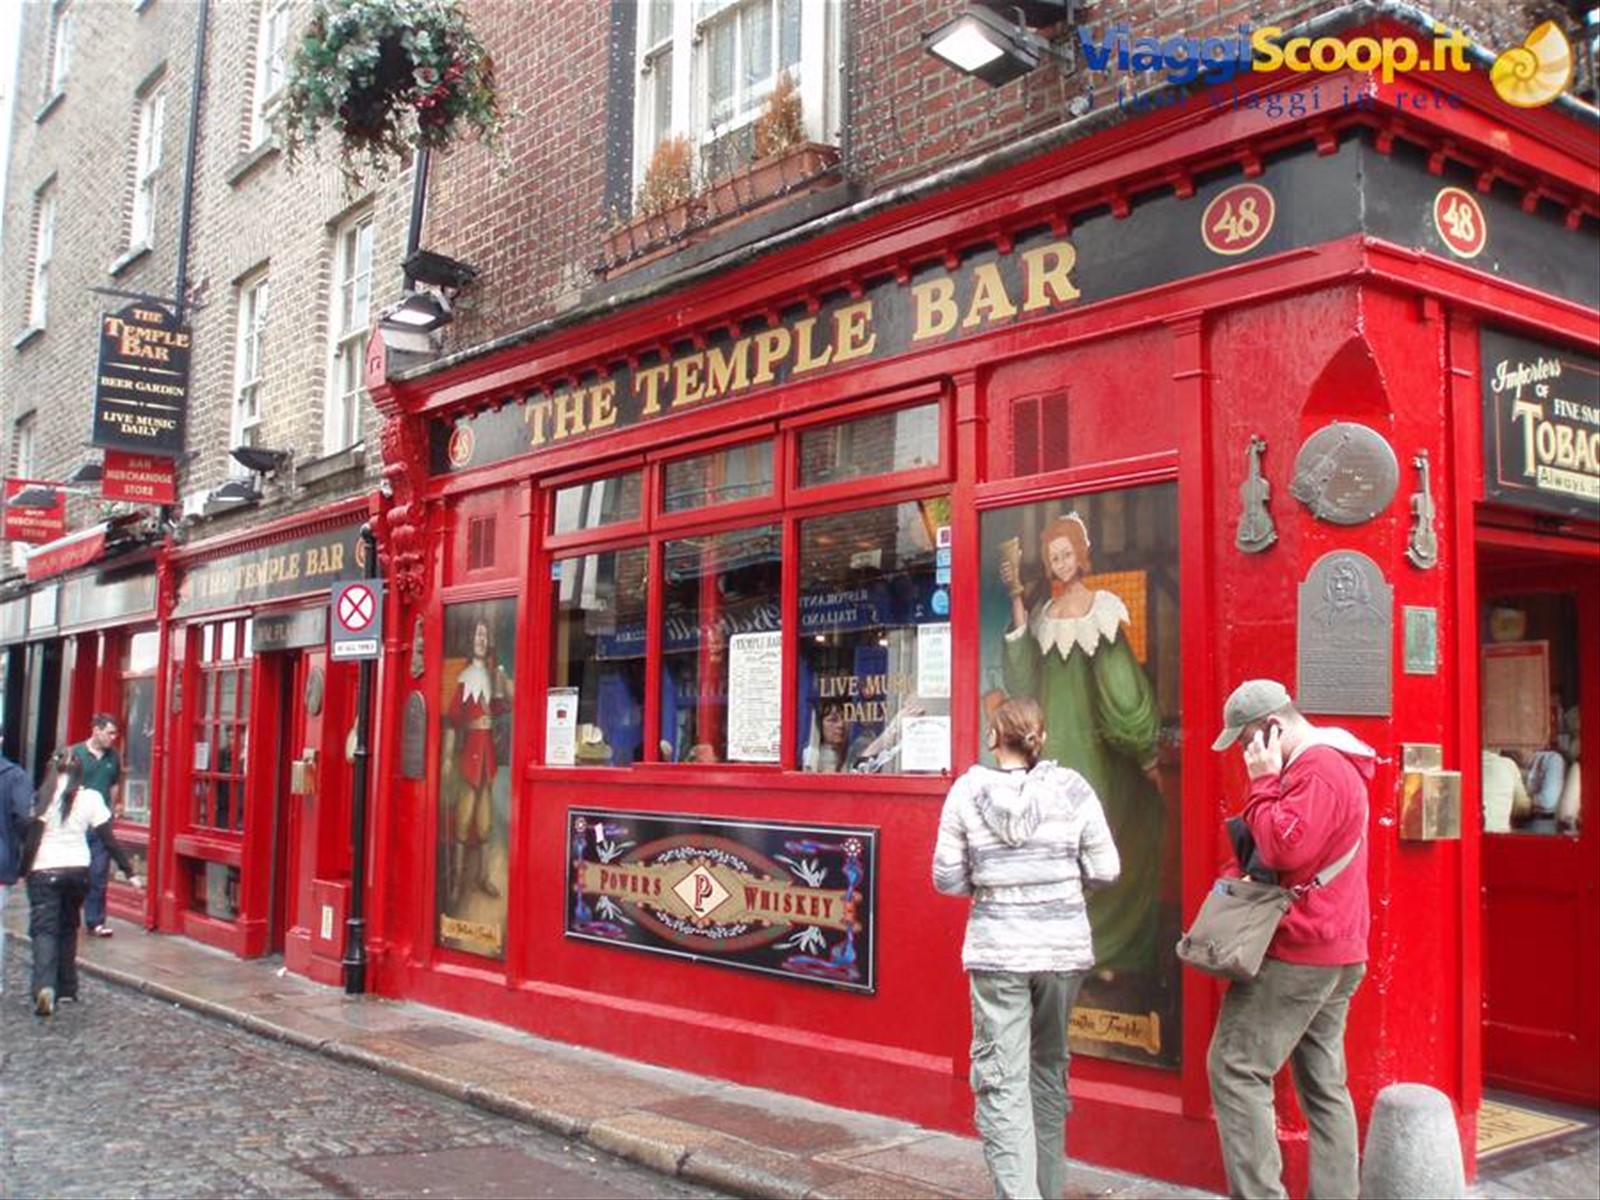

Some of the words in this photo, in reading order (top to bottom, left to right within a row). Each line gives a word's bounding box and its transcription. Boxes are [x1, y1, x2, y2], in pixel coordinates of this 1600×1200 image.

[1212, 196, 1261, 244] 48
[1445, 196, 1476, 243] 48
[132, 309, 164, 324] THE
[105, 317, 189, 348] TEMPLE
[524, 381, 619, 447] THE
[634, 300, 878, 416] TEMPLE
[911, 240, 1082, 343] BAR
[120, 339, 171, 361] BAR
[101, 376, 133, 390] BEER
[135, 381, 185, 396] GARDEN
[1491, 357, 1562, 398] Importers
[1535, 384, 1550, 398] OF
[1554, 398, 1581, 420] FINE
[103, 411, 133, 423] LIVE
[136, 415, 176, 430] MUSIC
[121, 424, 159, 437] DAILY
[201, 569, 227, 597] THE
[235, 553, 300, 590] TEMPLE
[306, 543, 344, 577] BAR
[820, 676, 859, 698] LIVE
[843, 701, 891, 723] DAILY
[600, 869, 662, 897] POWERS
[693, 873, 714, 913] P
[743, 885, 834, 919] WHISKEY
